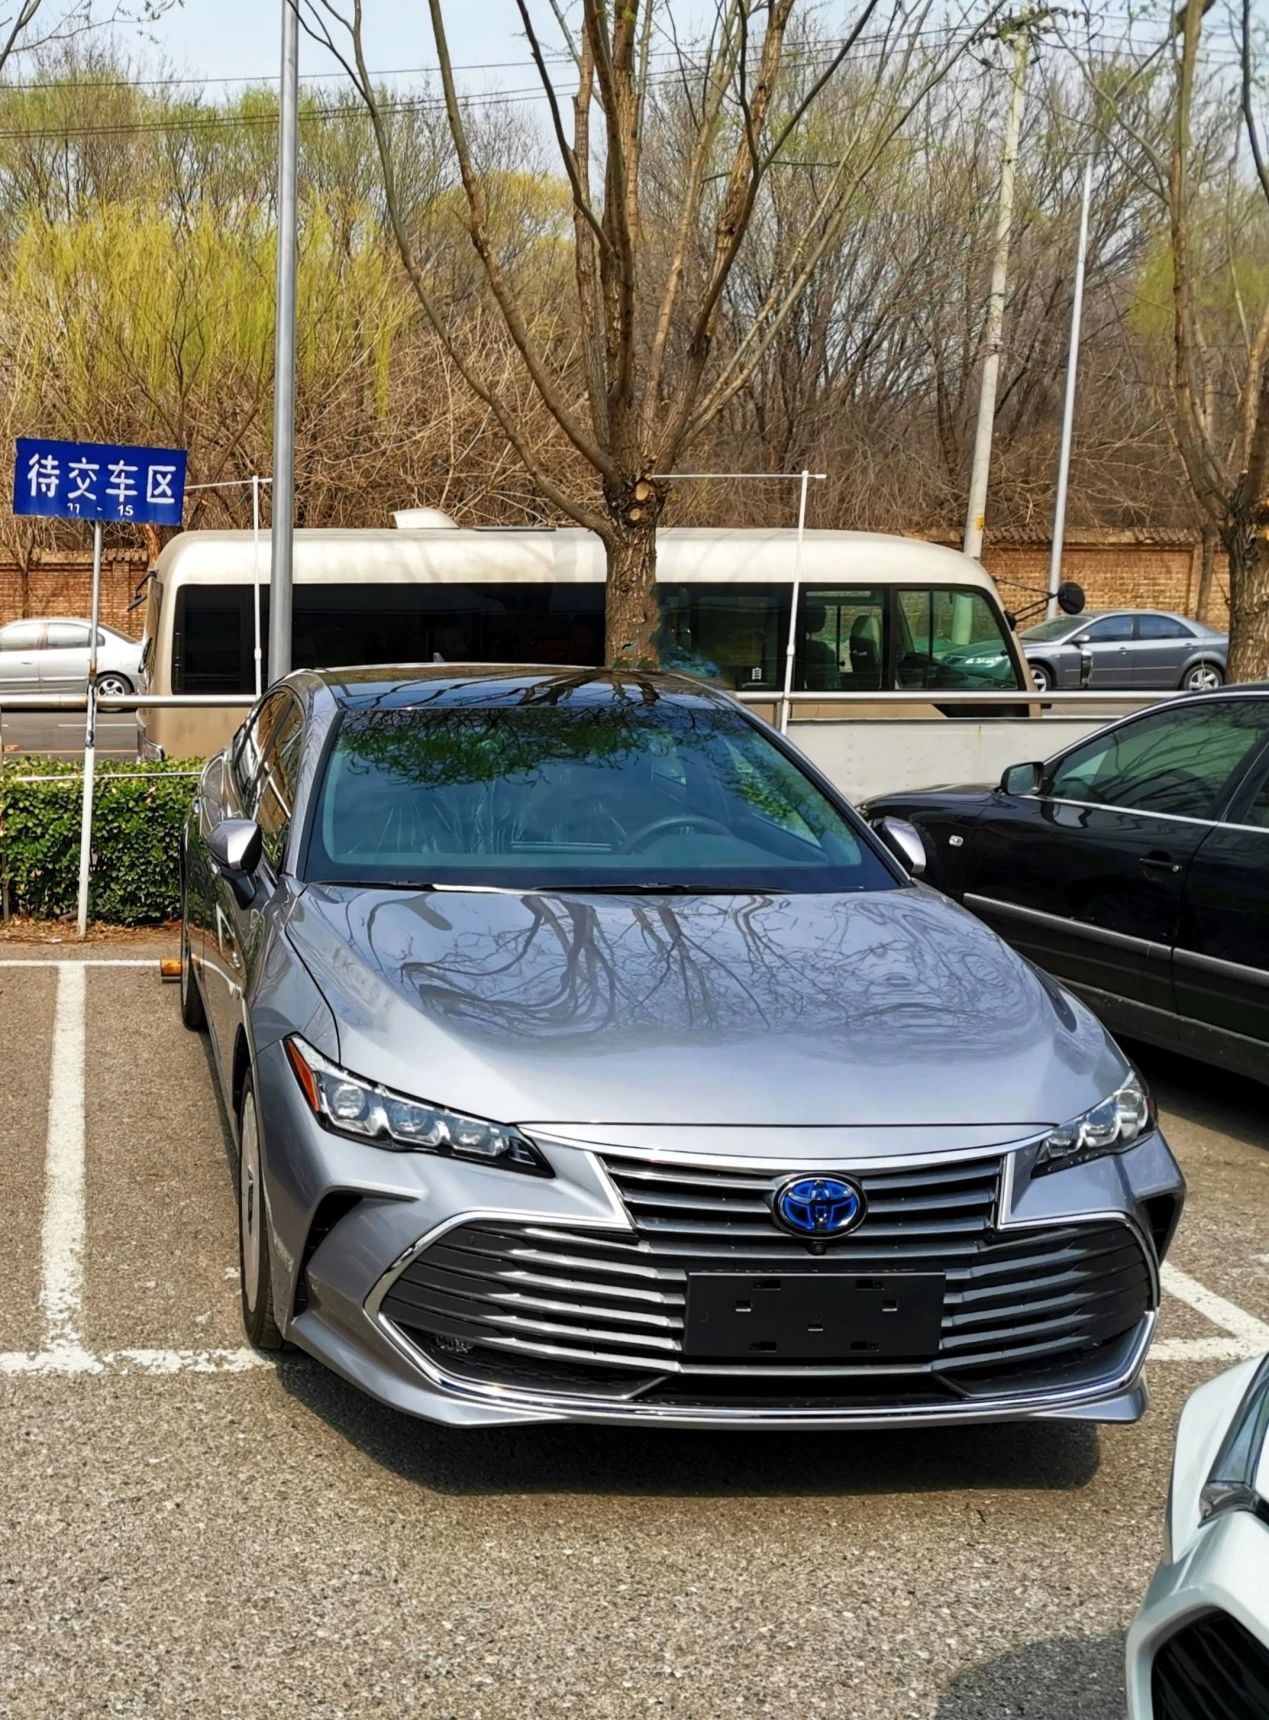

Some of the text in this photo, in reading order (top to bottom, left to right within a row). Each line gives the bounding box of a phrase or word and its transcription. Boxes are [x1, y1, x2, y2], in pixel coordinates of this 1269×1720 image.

[27, 453, 177, 504] 待交车区
[117, 504, 134, 517] 15
